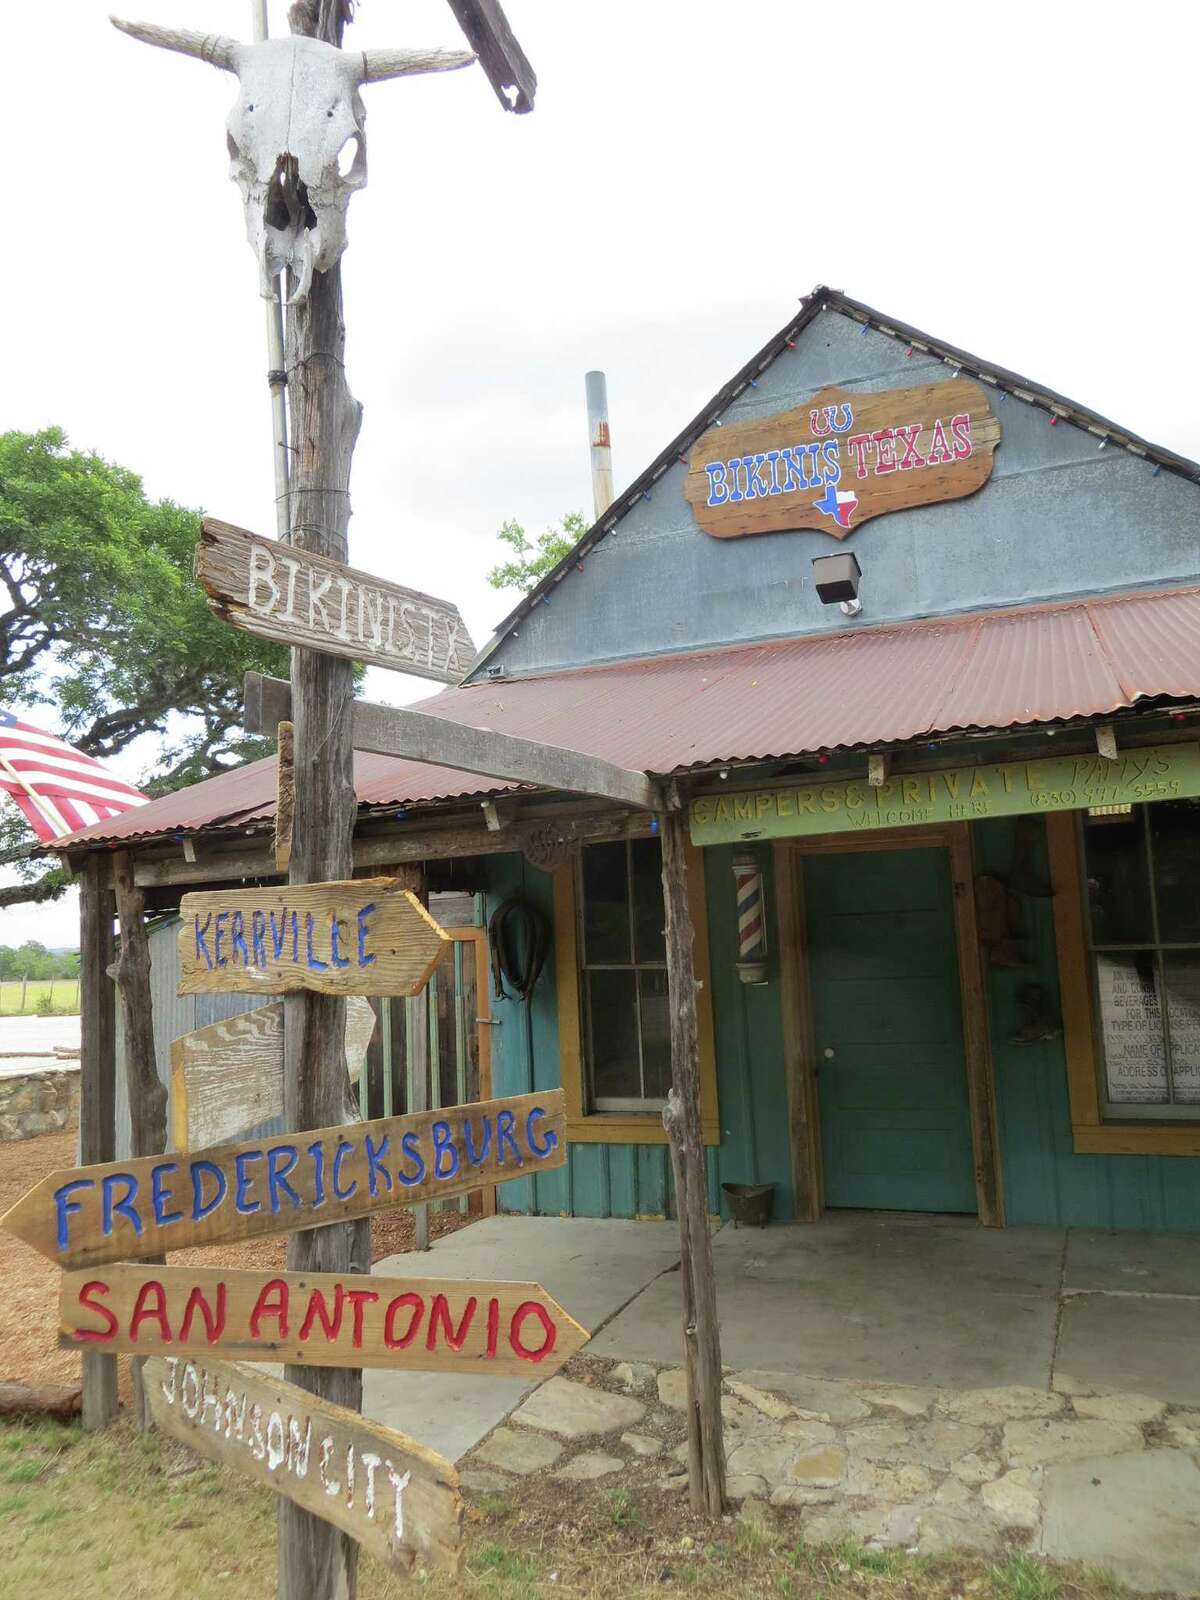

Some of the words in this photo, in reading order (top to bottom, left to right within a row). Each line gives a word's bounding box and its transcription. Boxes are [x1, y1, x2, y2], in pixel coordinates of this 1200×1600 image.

[706, 439, 841, 506] BIKINIS
[848, 415, 973, 479] TEXAS
[248, 543, 418, 663] BIKINIS
[691, 786, 839, 825] CAMPERS
[194, 903, 377, 971] KERRVILLE
[54, 1106, 558, 1253] FREDERICKSBURG
[73, 1279, 227, 1346] SAN
[249, 1278, 557, 1363] ANTONIO
[161, 1356, 312, 1479] JOHNSON
[320, 1435, 411, 1538] CITY
